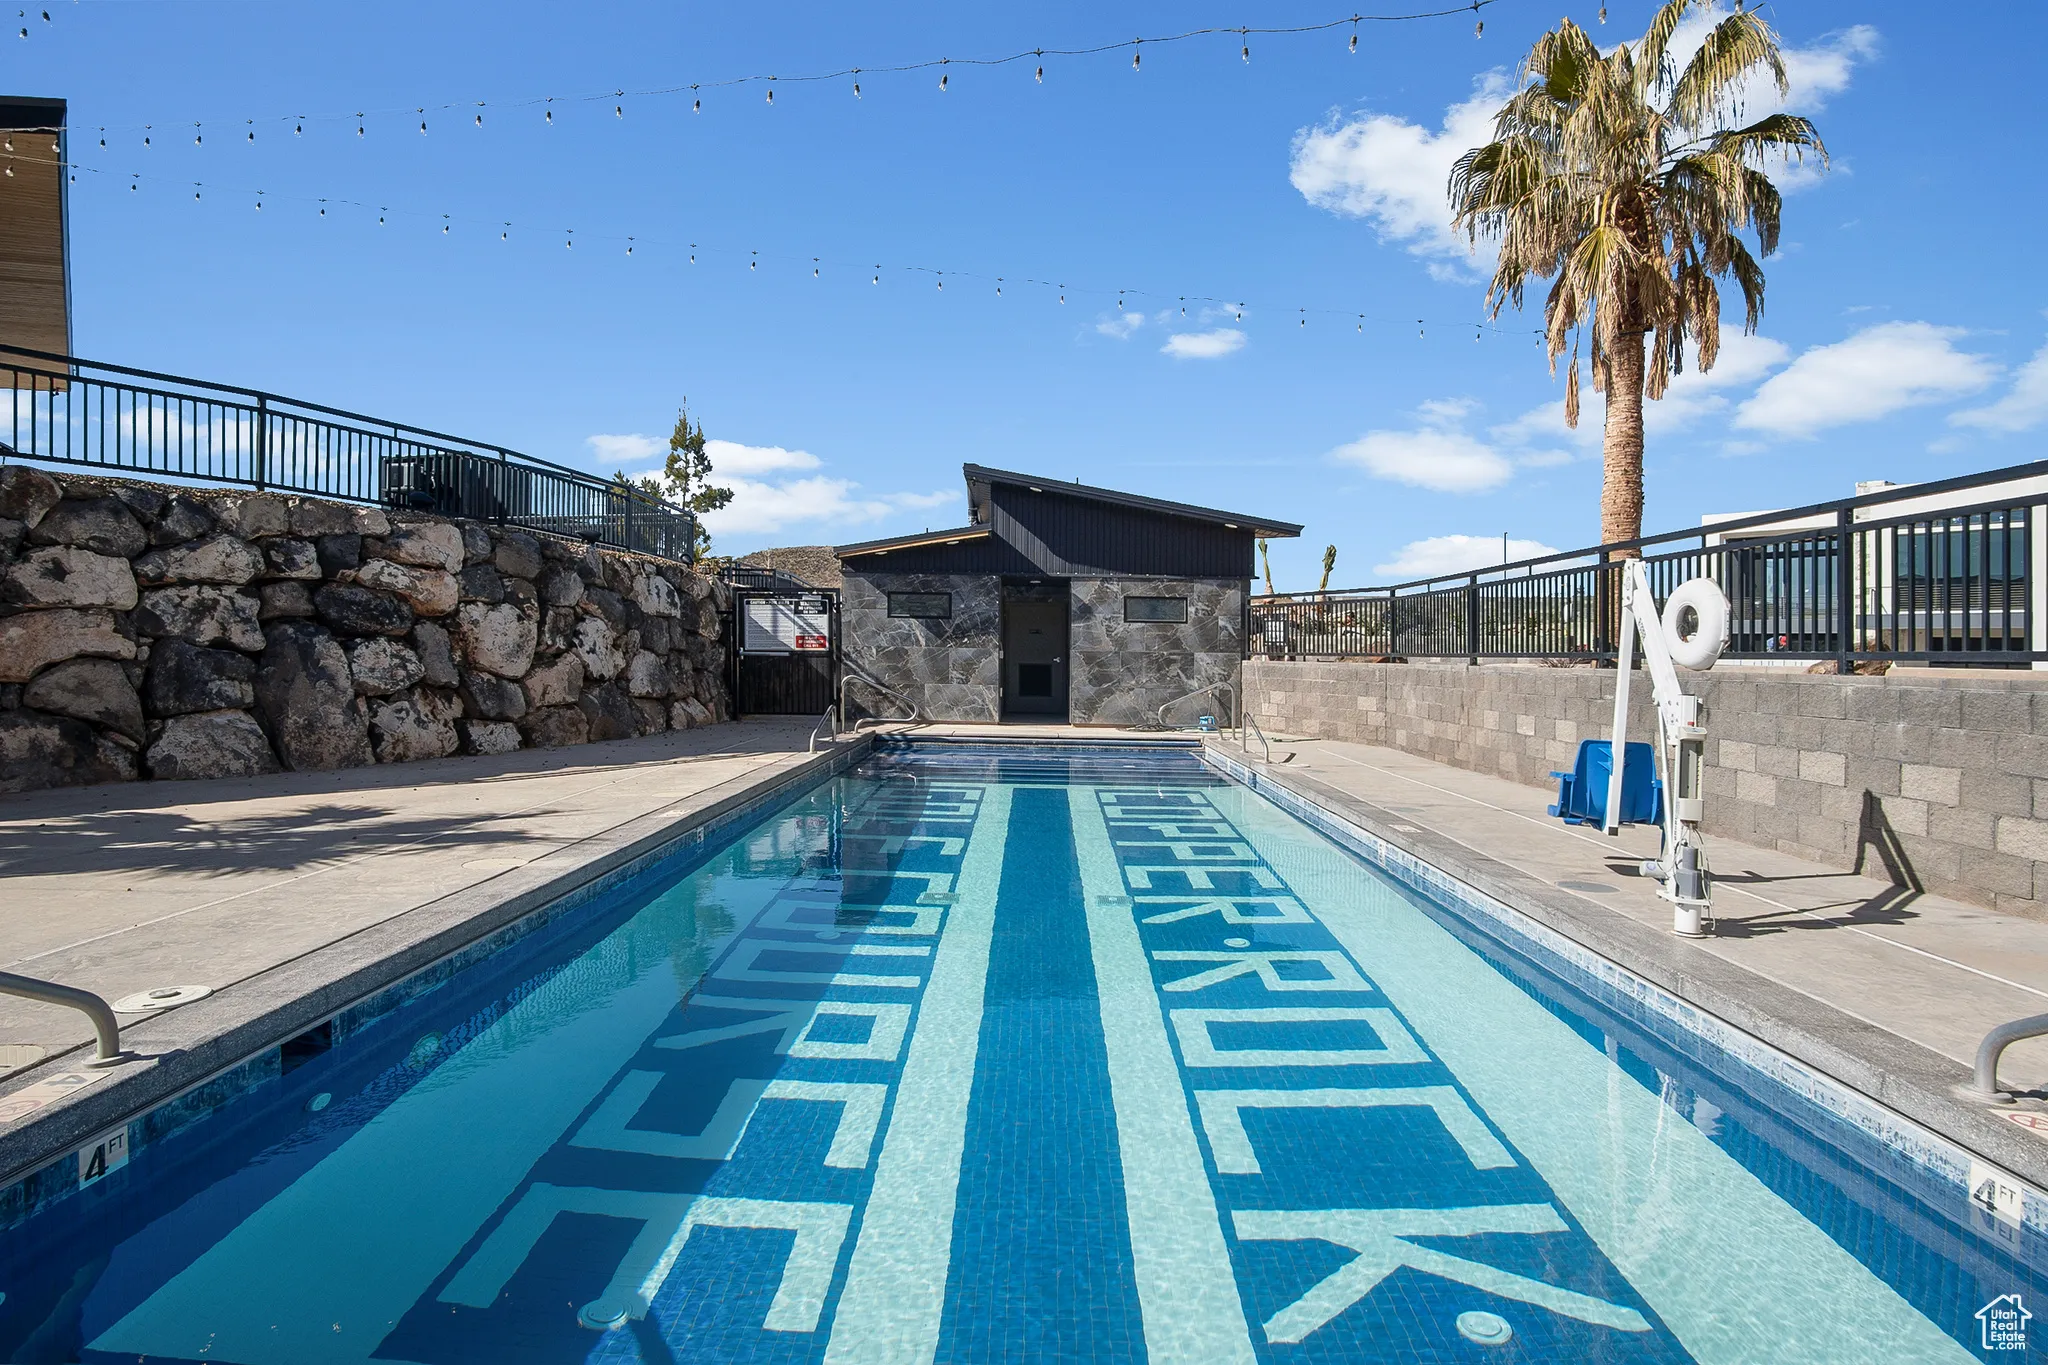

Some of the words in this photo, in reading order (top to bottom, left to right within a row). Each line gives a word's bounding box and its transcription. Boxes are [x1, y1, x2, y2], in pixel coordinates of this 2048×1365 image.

[1098, 792, 1315, 925] COPPER
[84, 1142, 109, 1182] 4
[109, 1133, 125, 1154] FT
[436, 868, 954, 1332] COURSE
[1152, 950, 1654, 1345] ROCK
[1973, 1178, 1998, 1213] 4
[2000, 1184, 2017, 1205] FT
